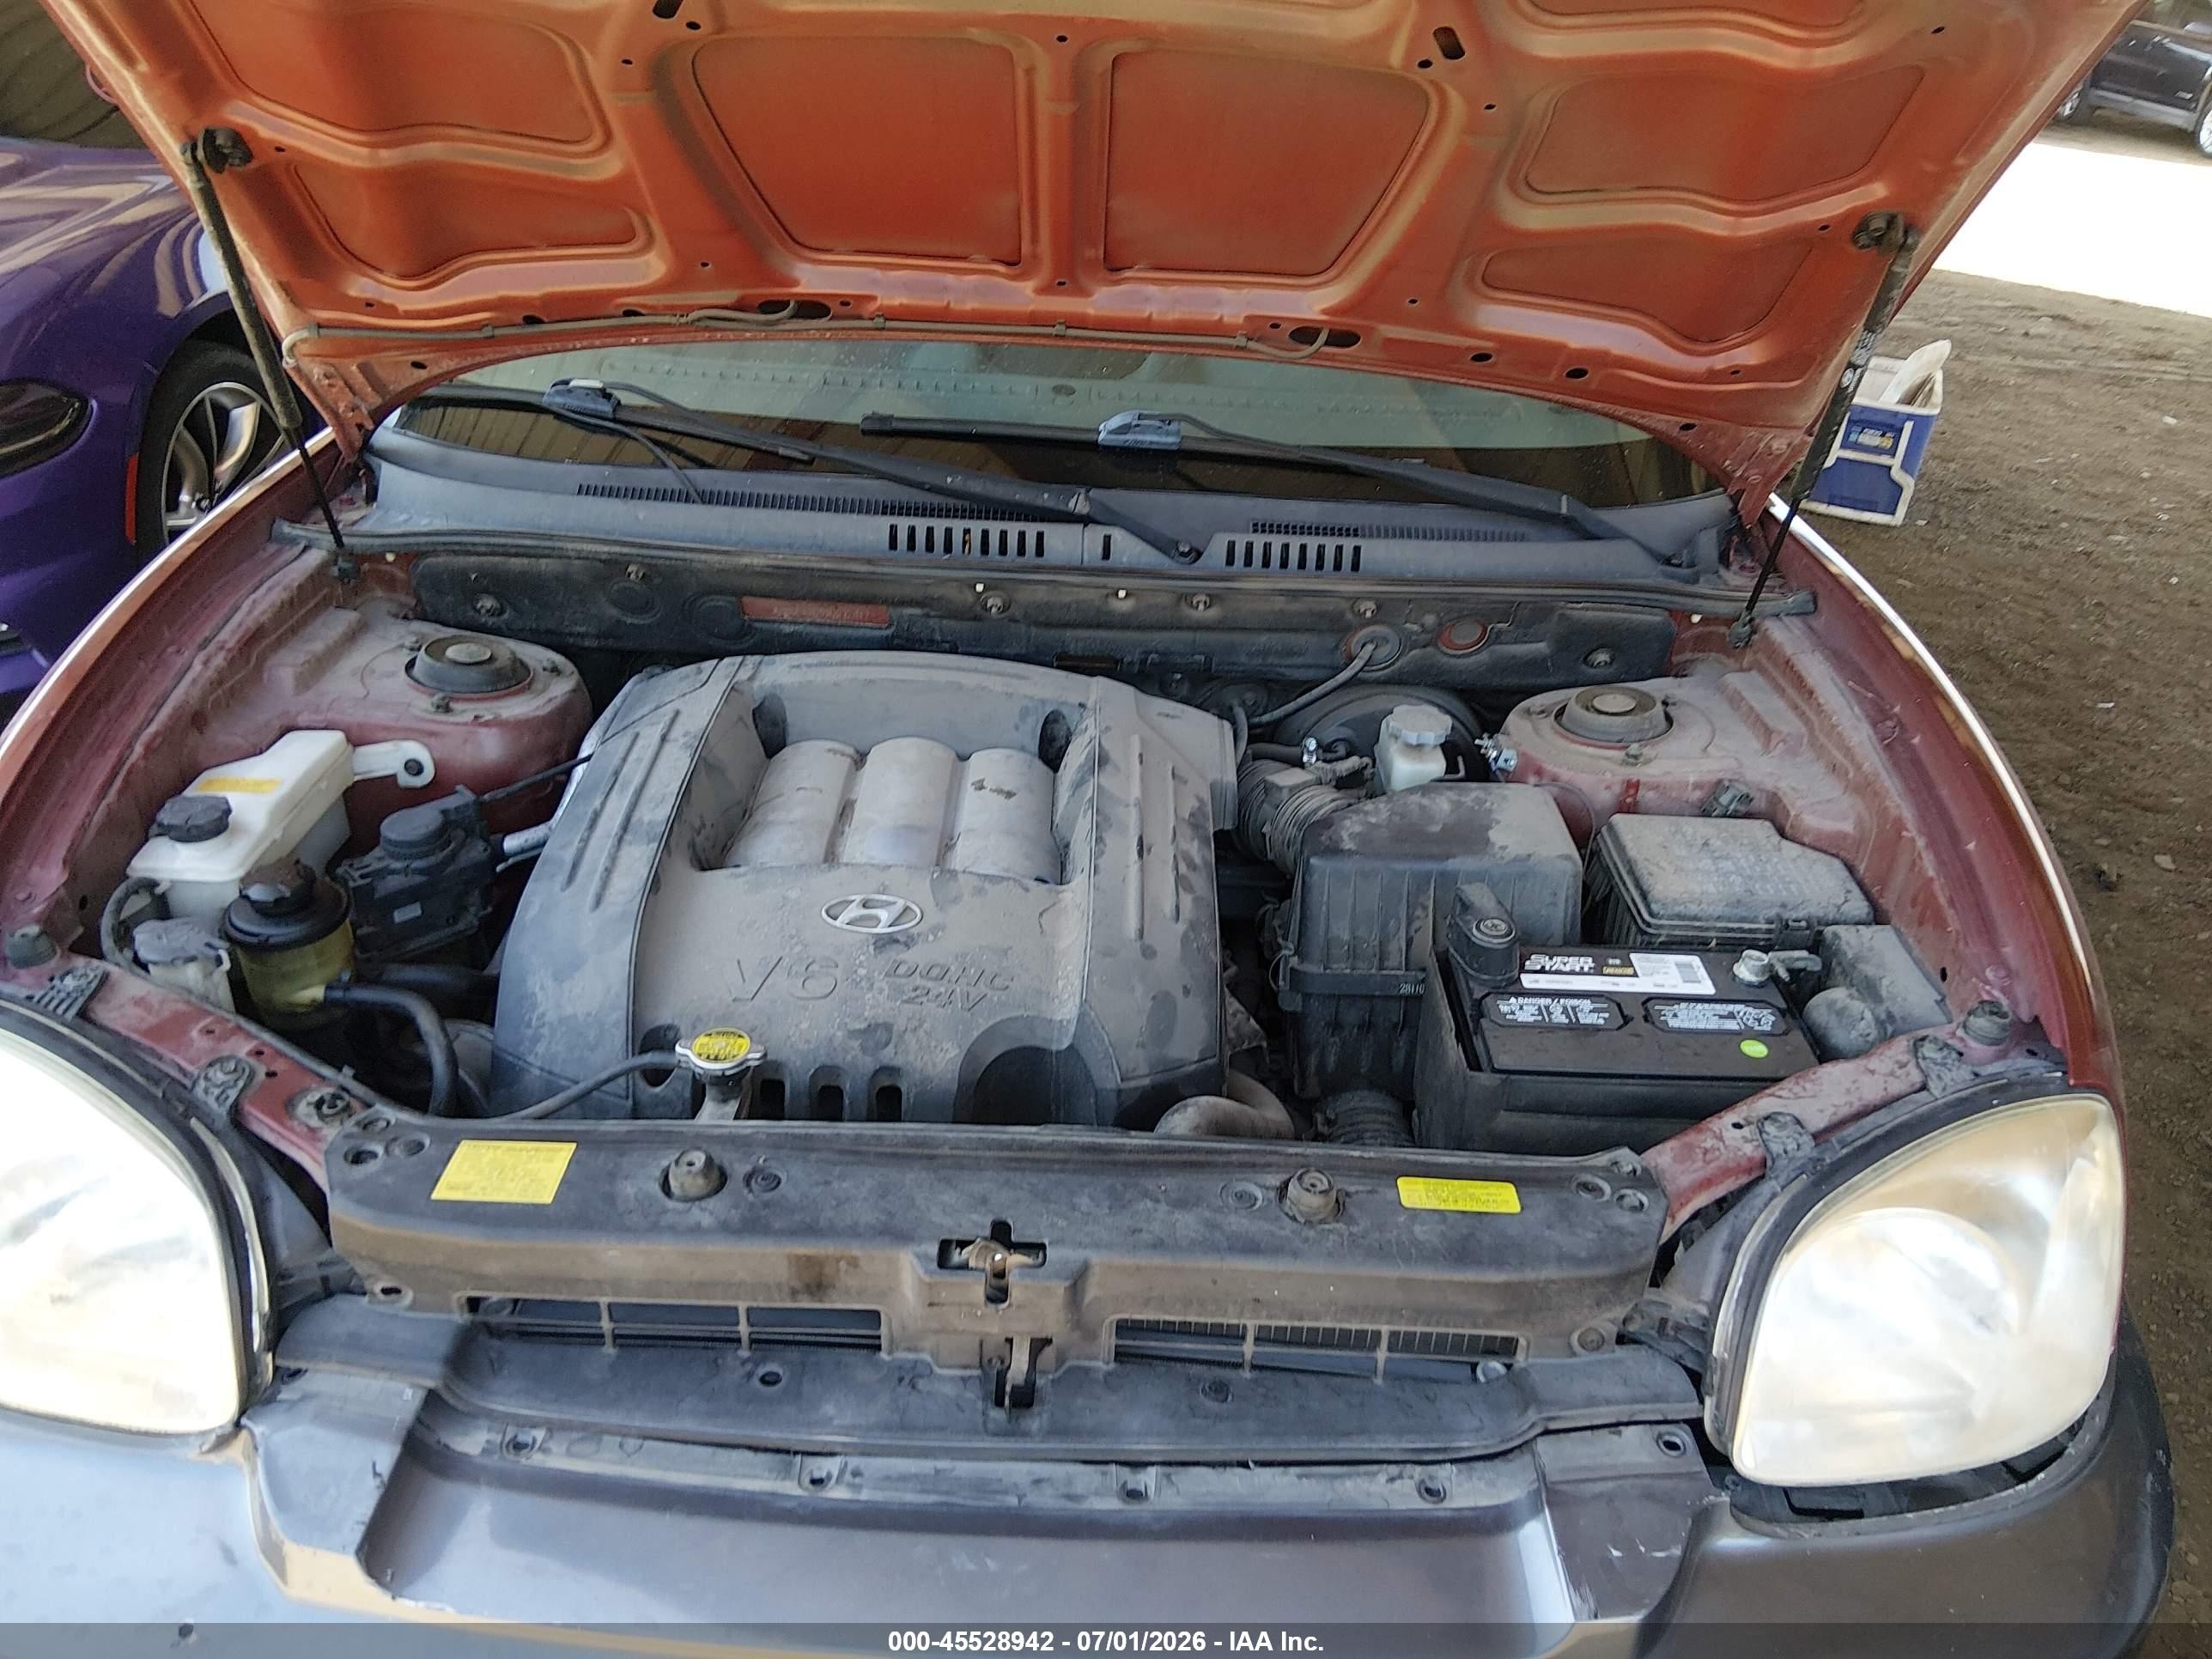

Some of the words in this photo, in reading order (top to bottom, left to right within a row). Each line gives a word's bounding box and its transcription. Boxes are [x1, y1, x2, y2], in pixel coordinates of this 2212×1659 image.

[1524, 960, 1595, 972] START
[1529, 953, 1595, 966] SUPER
[731, 956, 839, 1003] V6
[882, 959, 1014, 990] DOHC
[902, 985, 988, 1012] 24V
